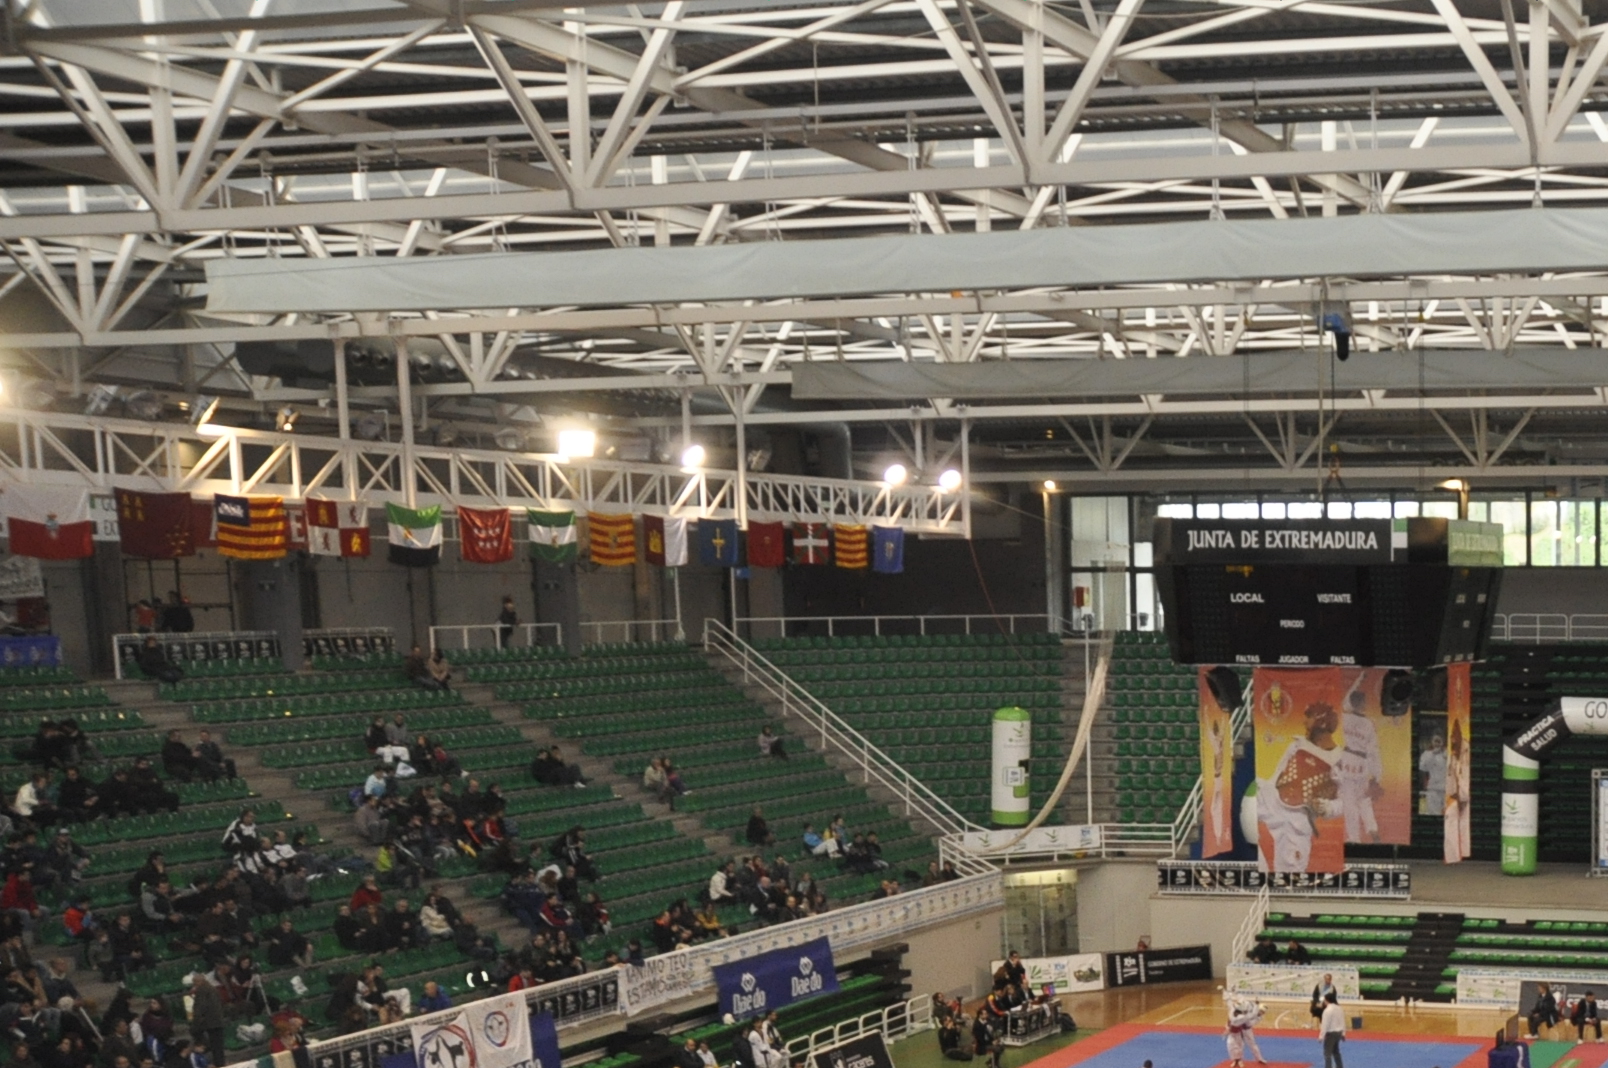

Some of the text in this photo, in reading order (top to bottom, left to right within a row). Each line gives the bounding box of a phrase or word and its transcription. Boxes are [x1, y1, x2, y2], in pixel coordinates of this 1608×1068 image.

[1187, 530, 1378, 551] JUNTA DE EXTREMADURA
[1230, 593, 1264, 603] LOCAL
[1317, 593, 1352, 603] VISITANTE
[1236, 654, 1260, 664] FALTAS
[1278, 655, 1309, 664] JUGADOR
[1330, 655, 1355, 665] FALTAS
[1530, 728, 1558, 751] SALUD
